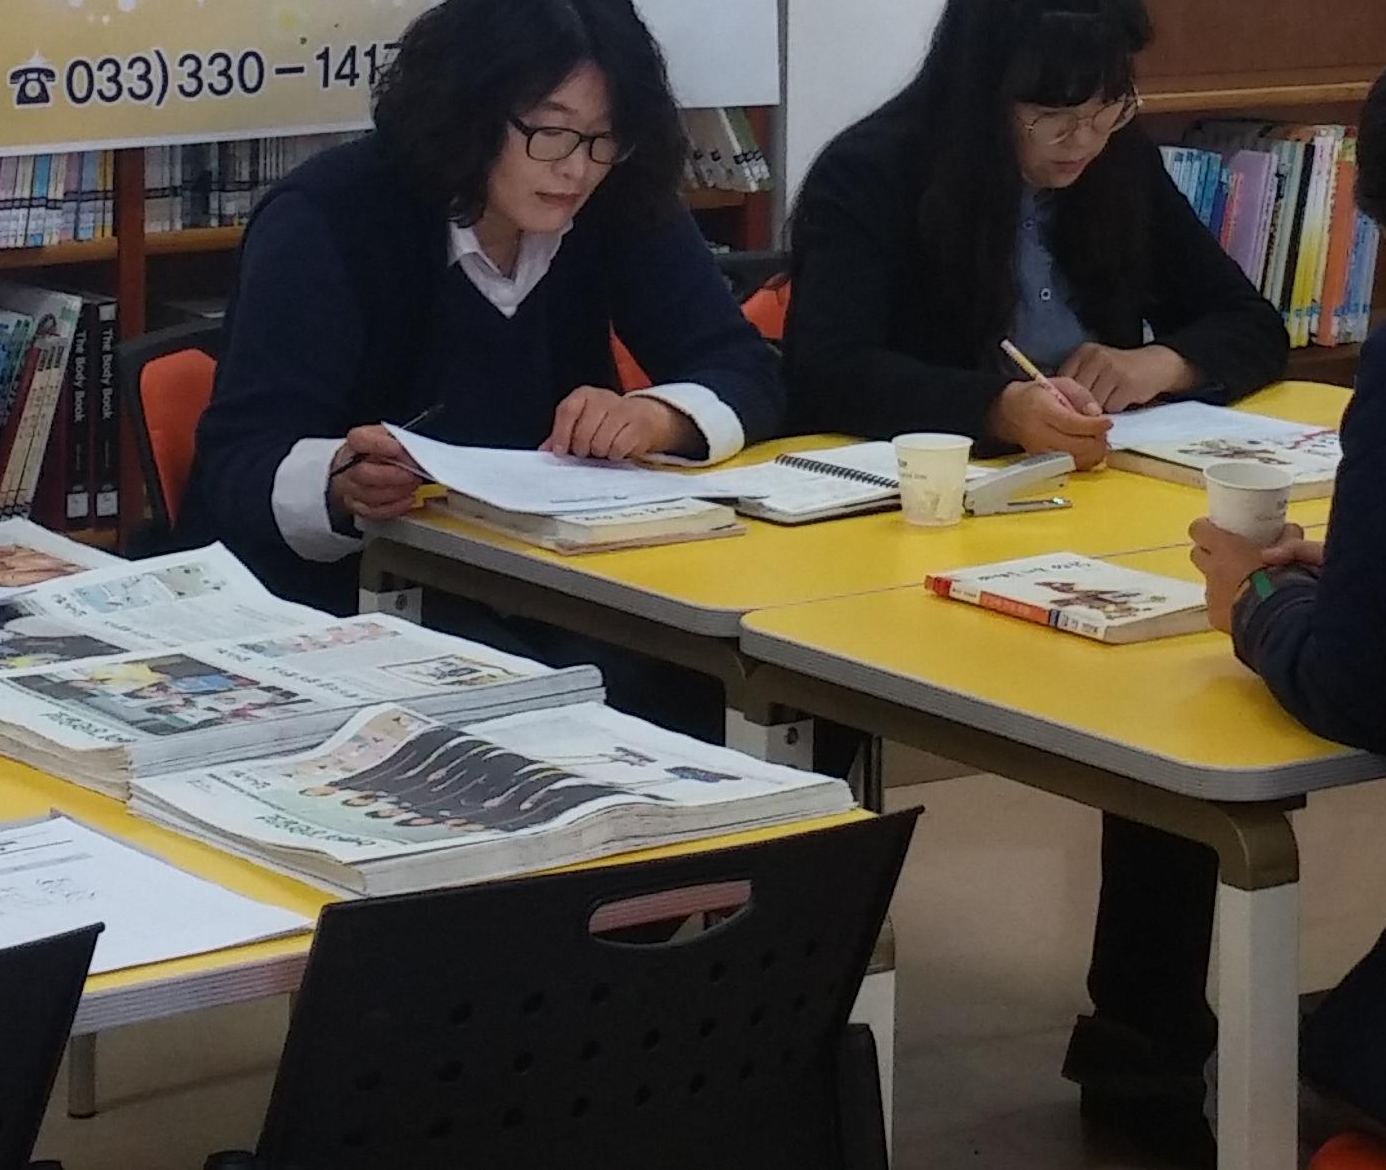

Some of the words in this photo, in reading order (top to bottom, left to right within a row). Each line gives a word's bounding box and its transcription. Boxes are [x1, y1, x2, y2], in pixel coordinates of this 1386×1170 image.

[76, 330, 87, 354] The
[101, 329, 114, 352] The
[73, 356, 87, 387] Body
[100, 354, 113, 385] Body
[74, 389, 86, 423] Book
[101, 387, 113, 420] Book
